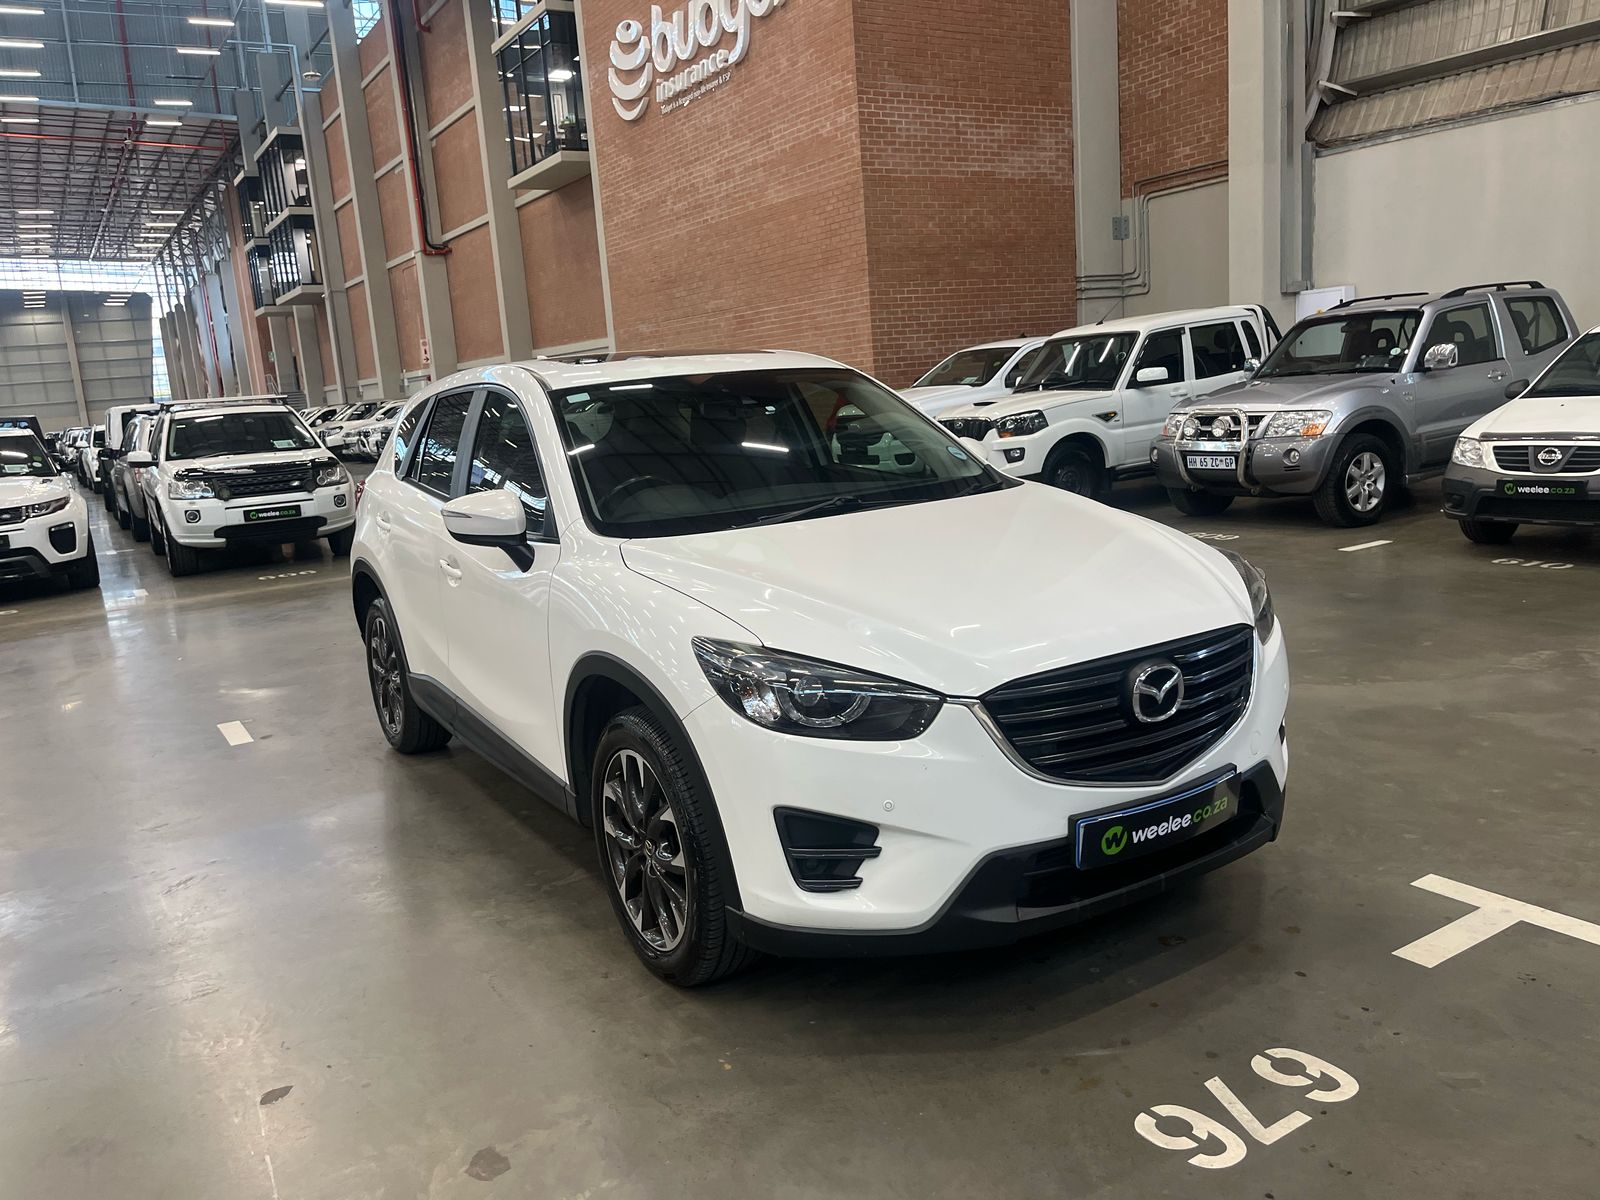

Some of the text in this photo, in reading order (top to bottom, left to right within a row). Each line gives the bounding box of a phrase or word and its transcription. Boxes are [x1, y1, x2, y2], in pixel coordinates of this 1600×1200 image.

[656, 49, 730, 102] insurance
[1199, 457, 1208, 467] 65
[1210, 457, 1220, 468] ZC
[1224, 457, 1234, 468] GP
[1517, 485, 1575, 494] weelee.co.za
[258, 509, 296, 518] weelee.co.za
[1491, 558, 1574, 569] 610
[1132, 796, 1229, 844] weelee.co.za
[1134, 1047, 1360, 1169] 676
